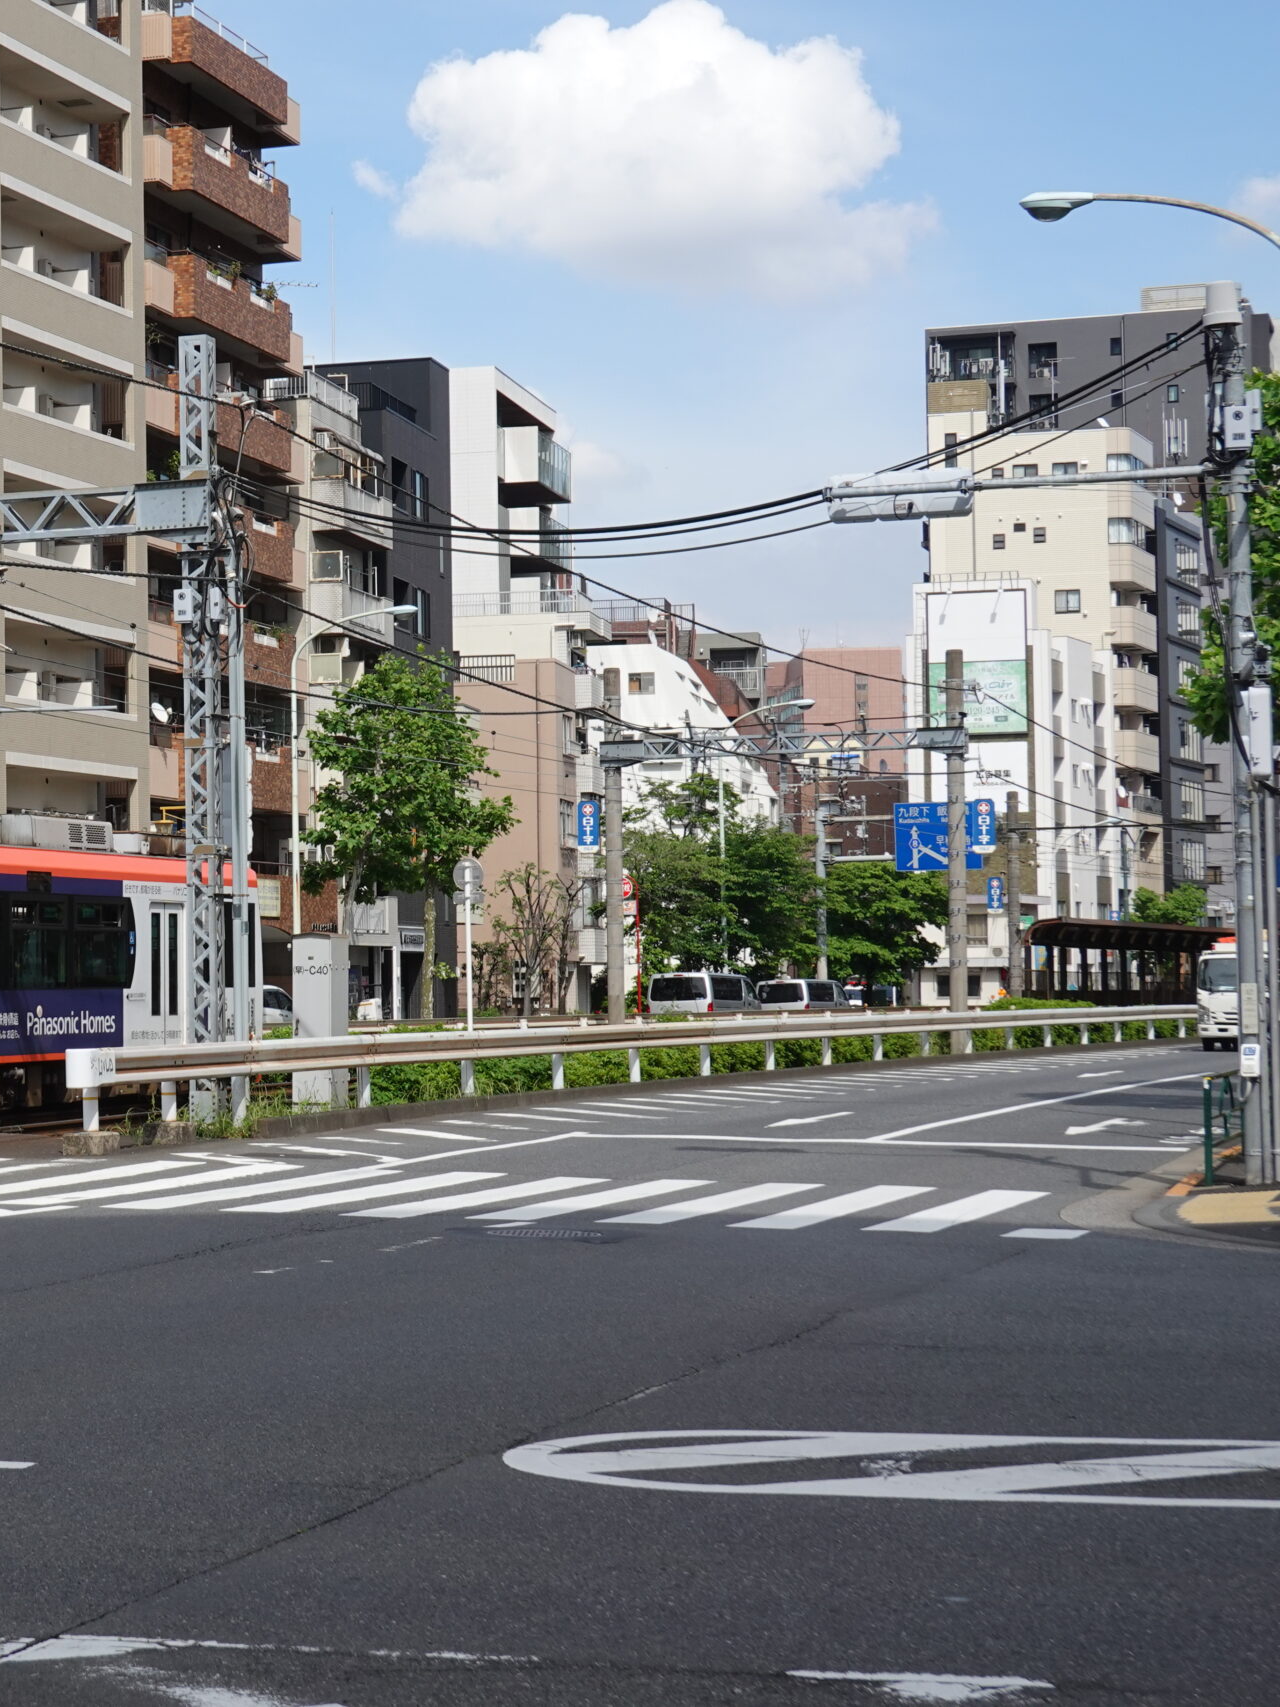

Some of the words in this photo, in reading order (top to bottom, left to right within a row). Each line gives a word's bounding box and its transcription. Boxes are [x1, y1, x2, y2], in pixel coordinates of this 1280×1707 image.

[898, 806, 930, 818] 九段下
[582, 815, 594, 845] 白十字
[977, 815, 990, 845] 白十字
[991, 888, 1000, 909] 白十字
[26, 1009, 79, 1036] Panasonic
[80, 1009, 116, 1034] Homes
